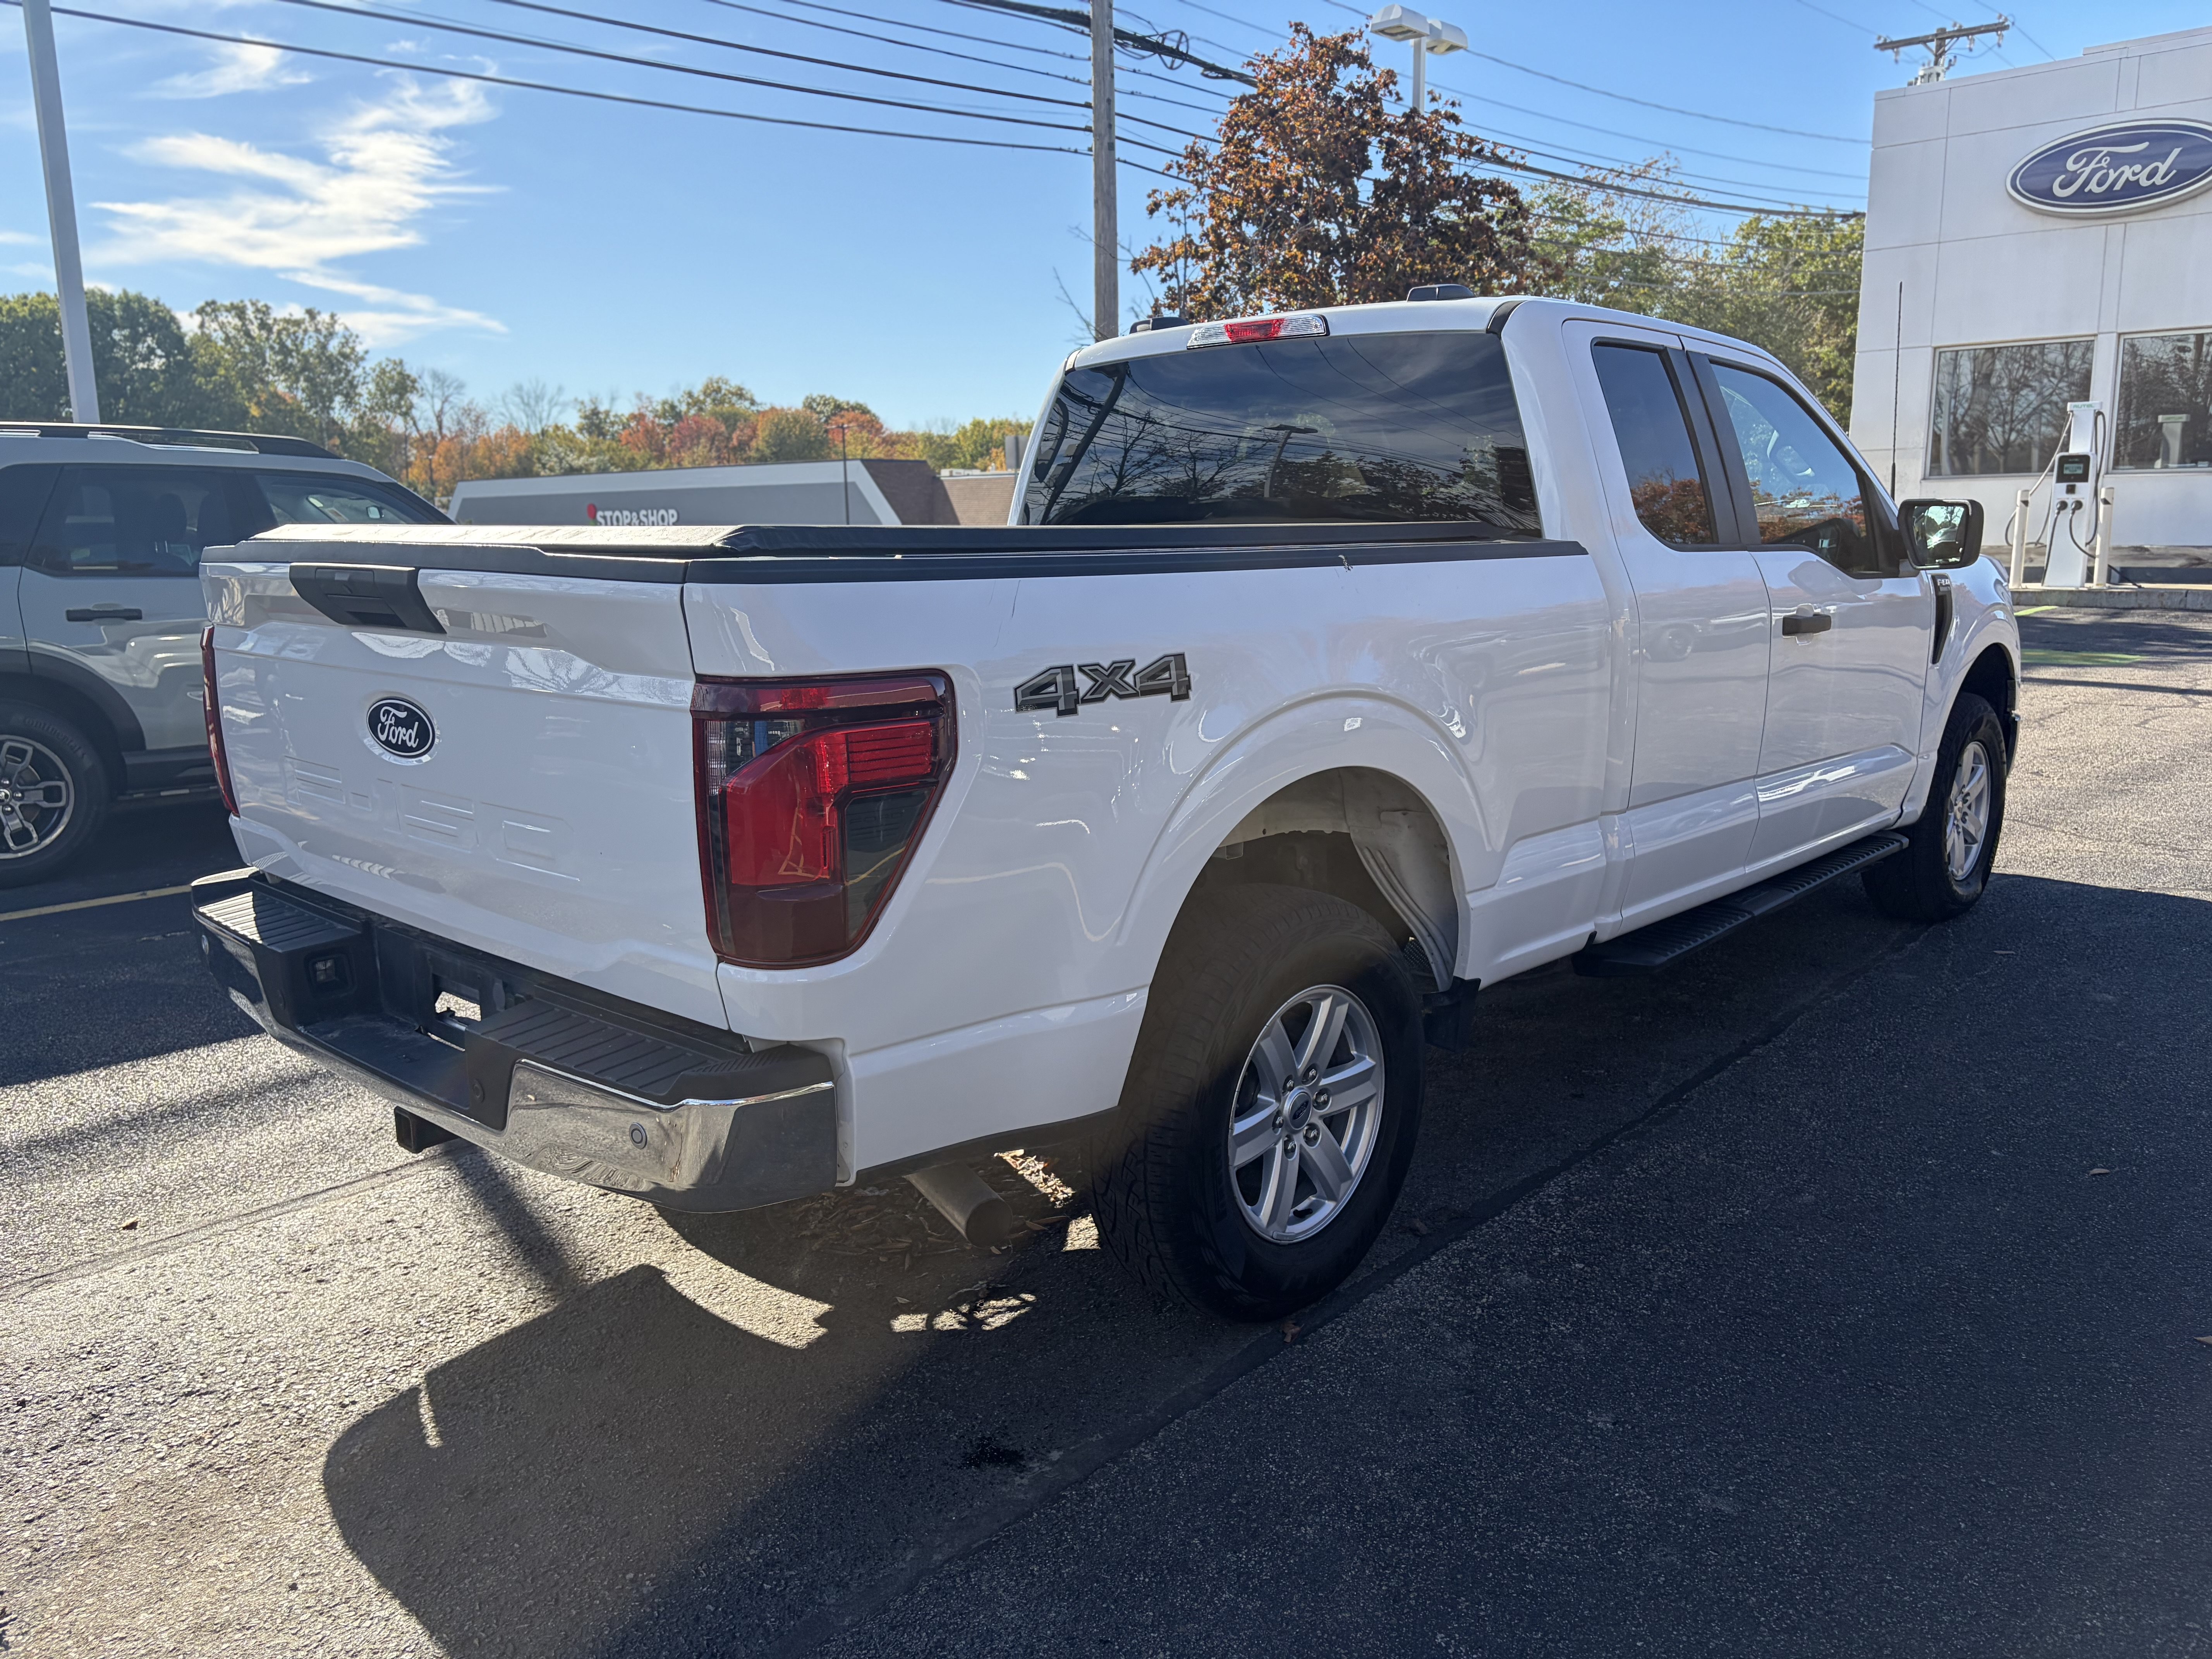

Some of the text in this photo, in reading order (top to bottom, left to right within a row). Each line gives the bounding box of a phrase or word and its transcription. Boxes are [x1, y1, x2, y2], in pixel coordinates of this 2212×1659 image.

[2053, 141, 2183, 198] Ford
[378, 706, 419, 748] Ford
[282, 755, 582, 882] F-150
